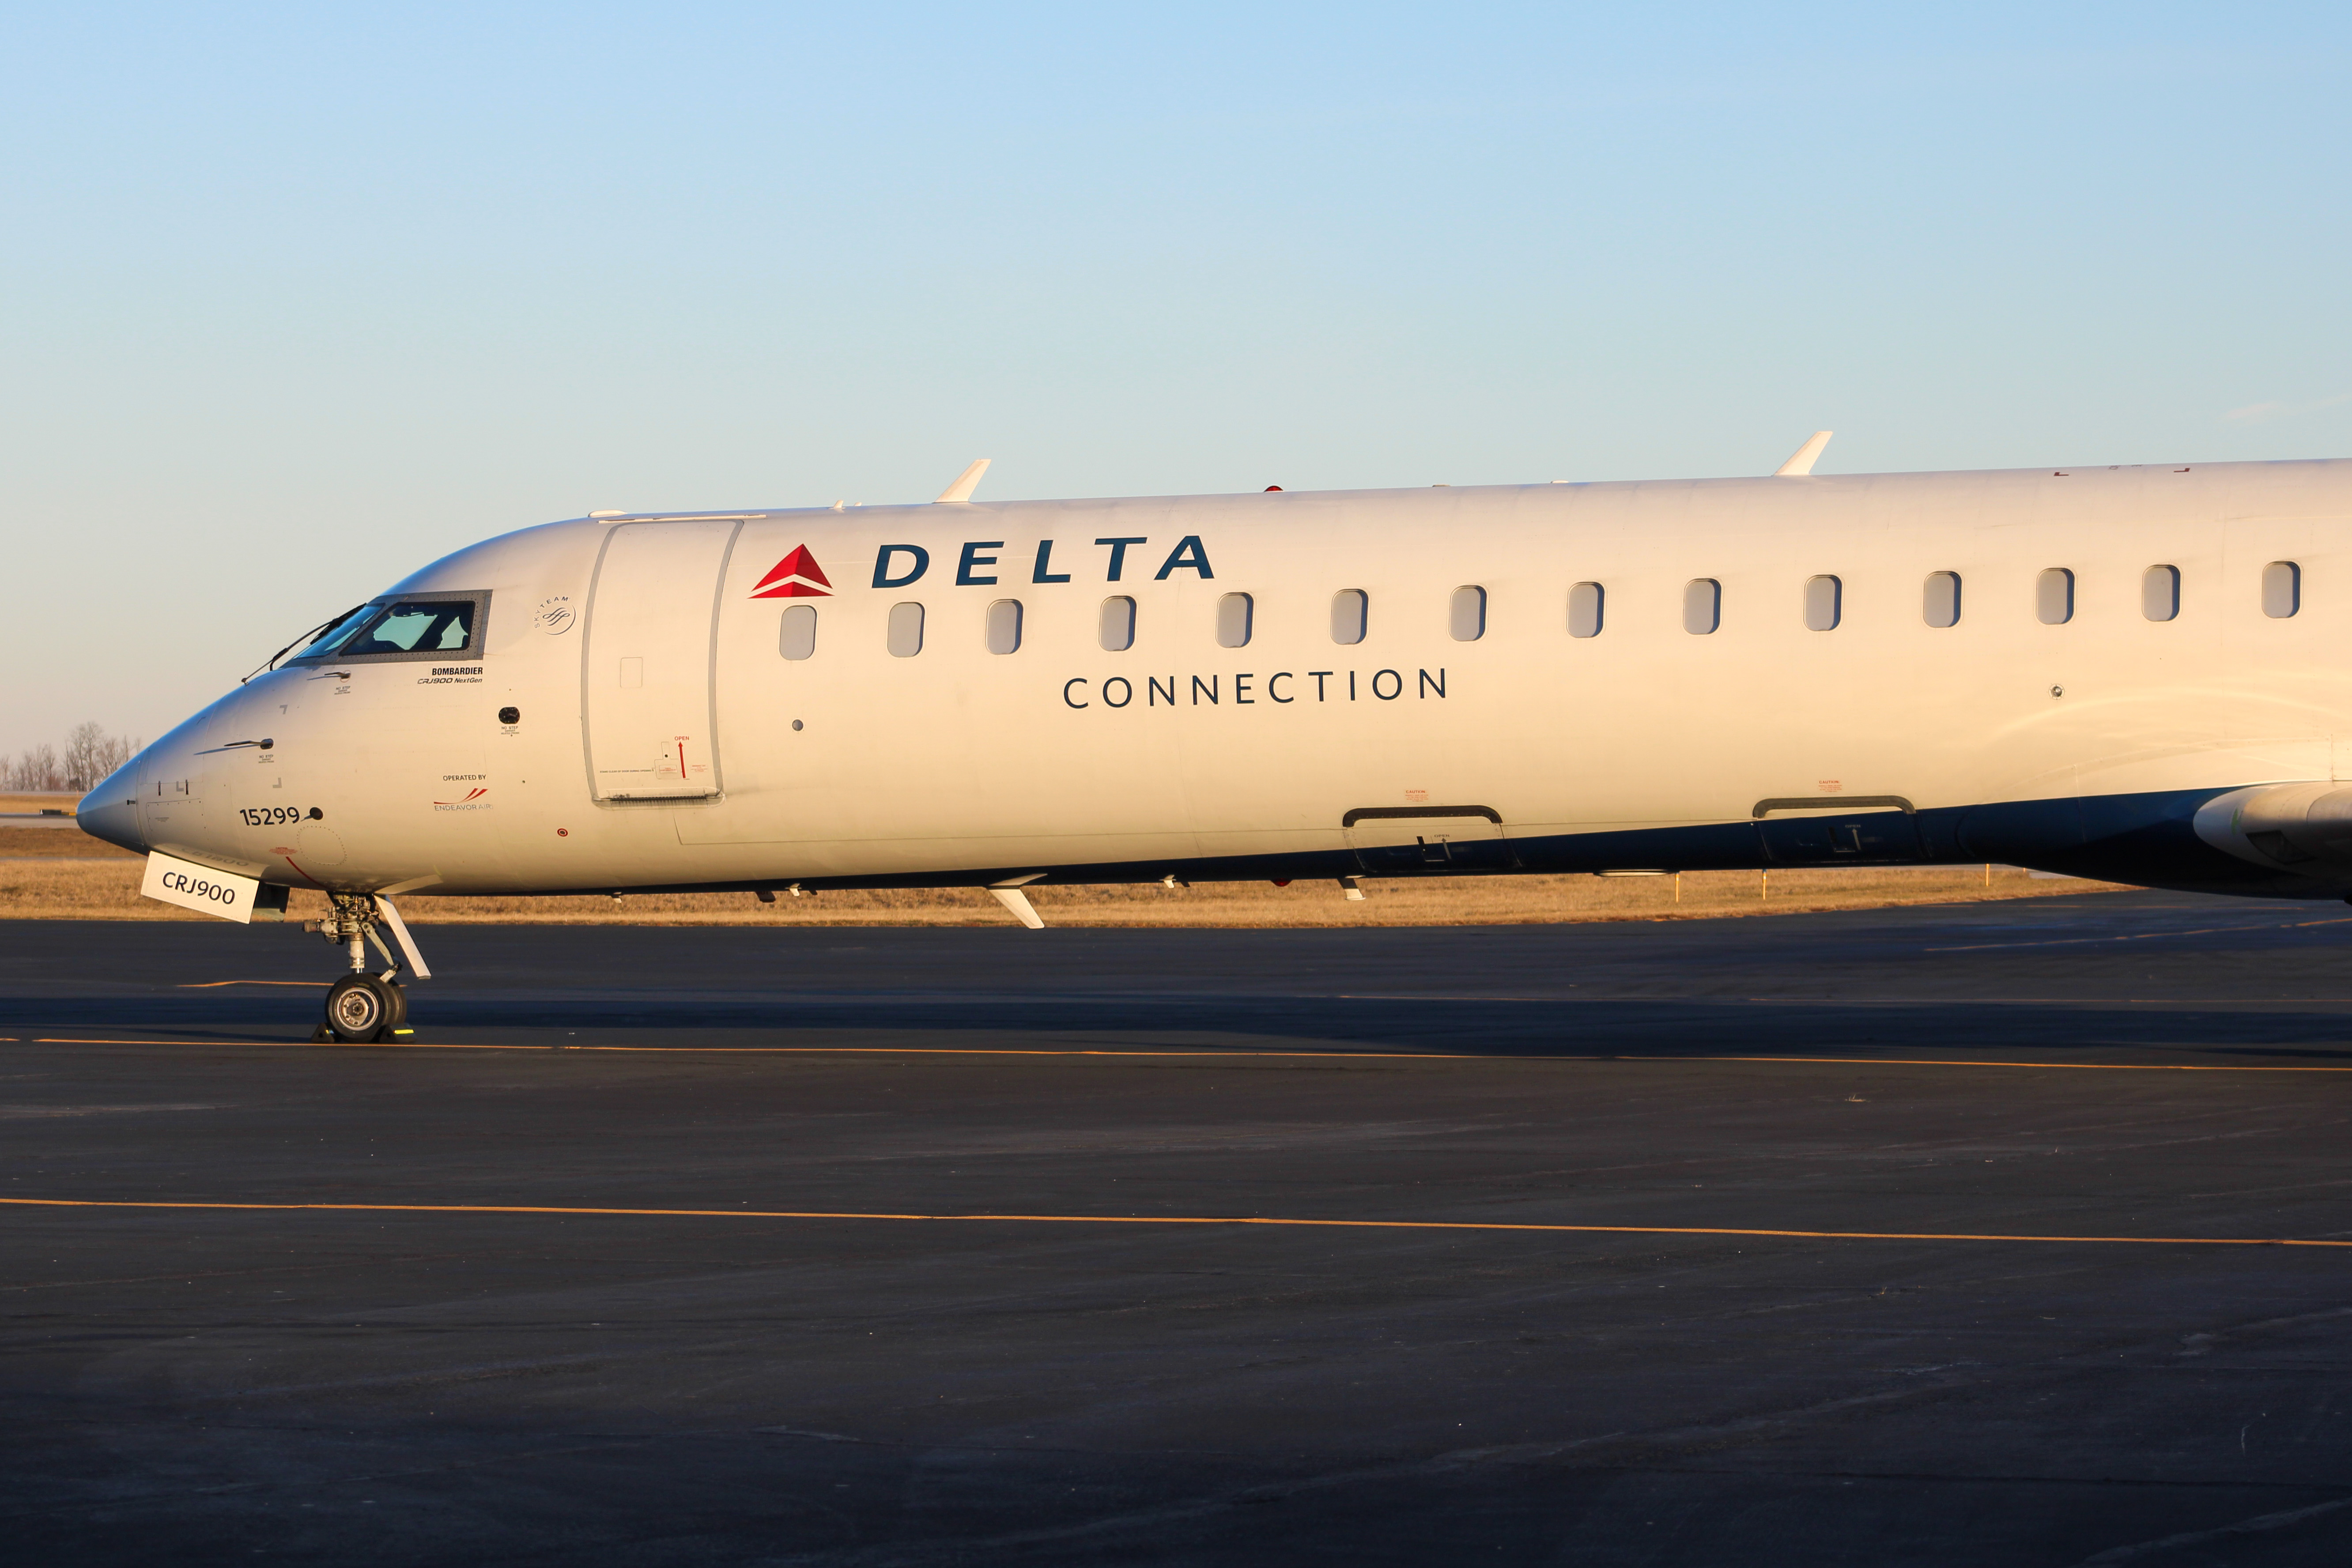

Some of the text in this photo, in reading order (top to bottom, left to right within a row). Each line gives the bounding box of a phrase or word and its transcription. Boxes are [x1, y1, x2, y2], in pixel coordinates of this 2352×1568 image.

[872, 535, 1215, 588] DELTA
[534, 596, 569, 629] SKYTEAM
[432, 667, 483, 676] BOMBARDIER
[1063, 668, 1446, 709] CONNECTION
[239, 807, 300, 826] 15299
[162, 871, 235, 905] CRJ900
